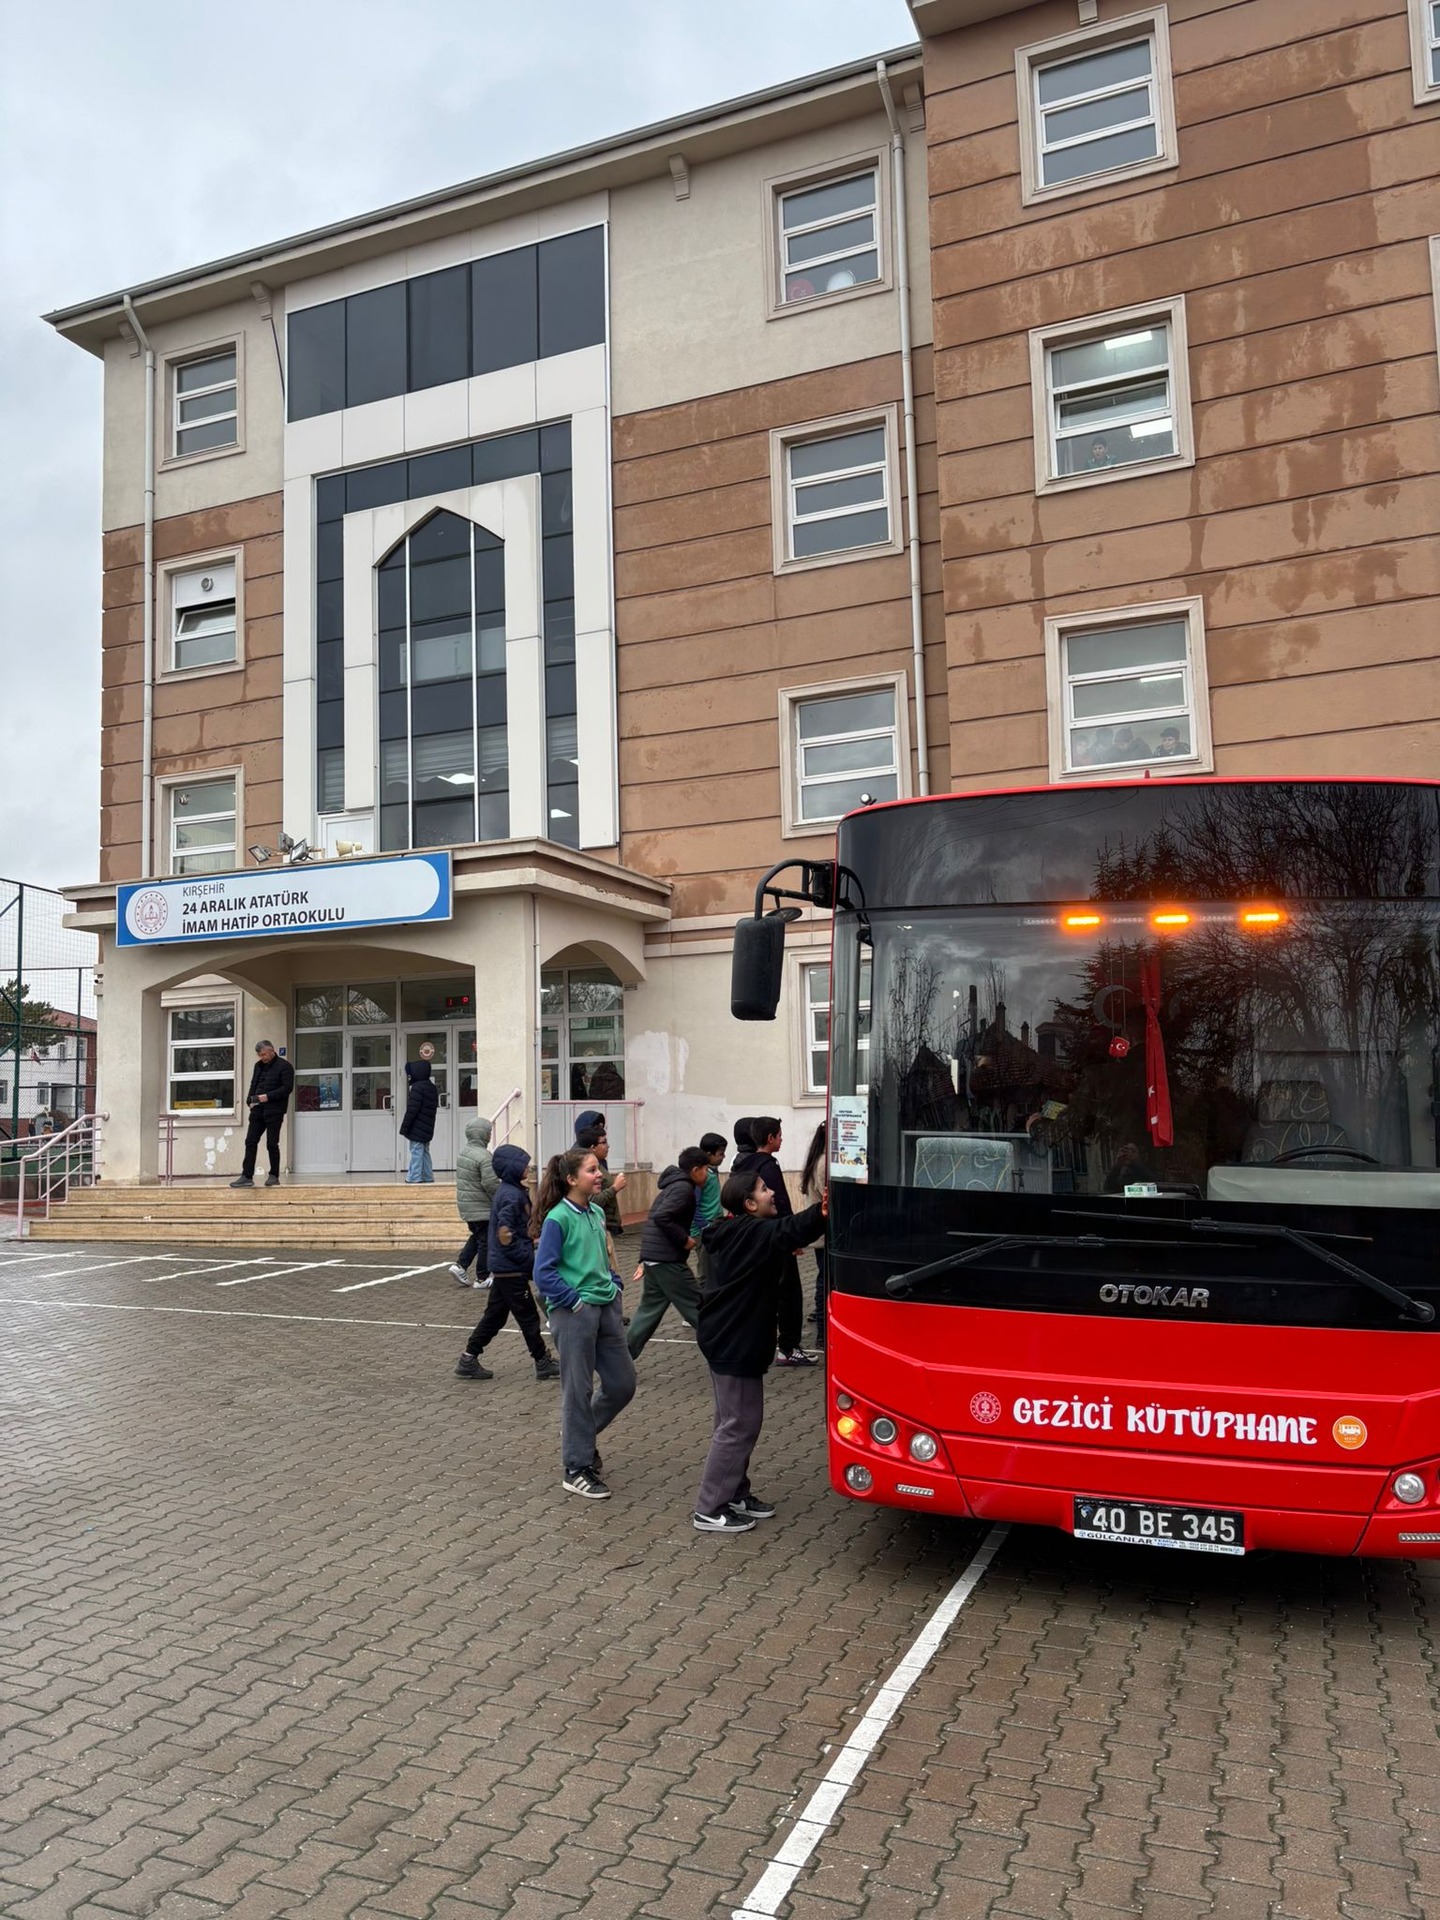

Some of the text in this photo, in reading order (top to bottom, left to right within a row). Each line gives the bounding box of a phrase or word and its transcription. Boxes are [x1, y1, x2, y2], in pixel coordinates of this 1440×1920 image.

[182, 881, 225, 899] KIRŞEHİR
[182, 902, 198, 916] 24
[200, 896, 247, 914] ARALIK
[249, 890, 309, 909] ATATÜRK
[182, 907, 345, 934] İMAM HATİP ORTAOKULU
[1099, 1283, 1210, 1308] OTOKAR
[1013, 1394, 1114, 1431] GEZİCİ
[1126, 1402, 1318, 1445] KÜTÜPHANE
[1092, 1506, 1236, 1543] 40 BE 345
